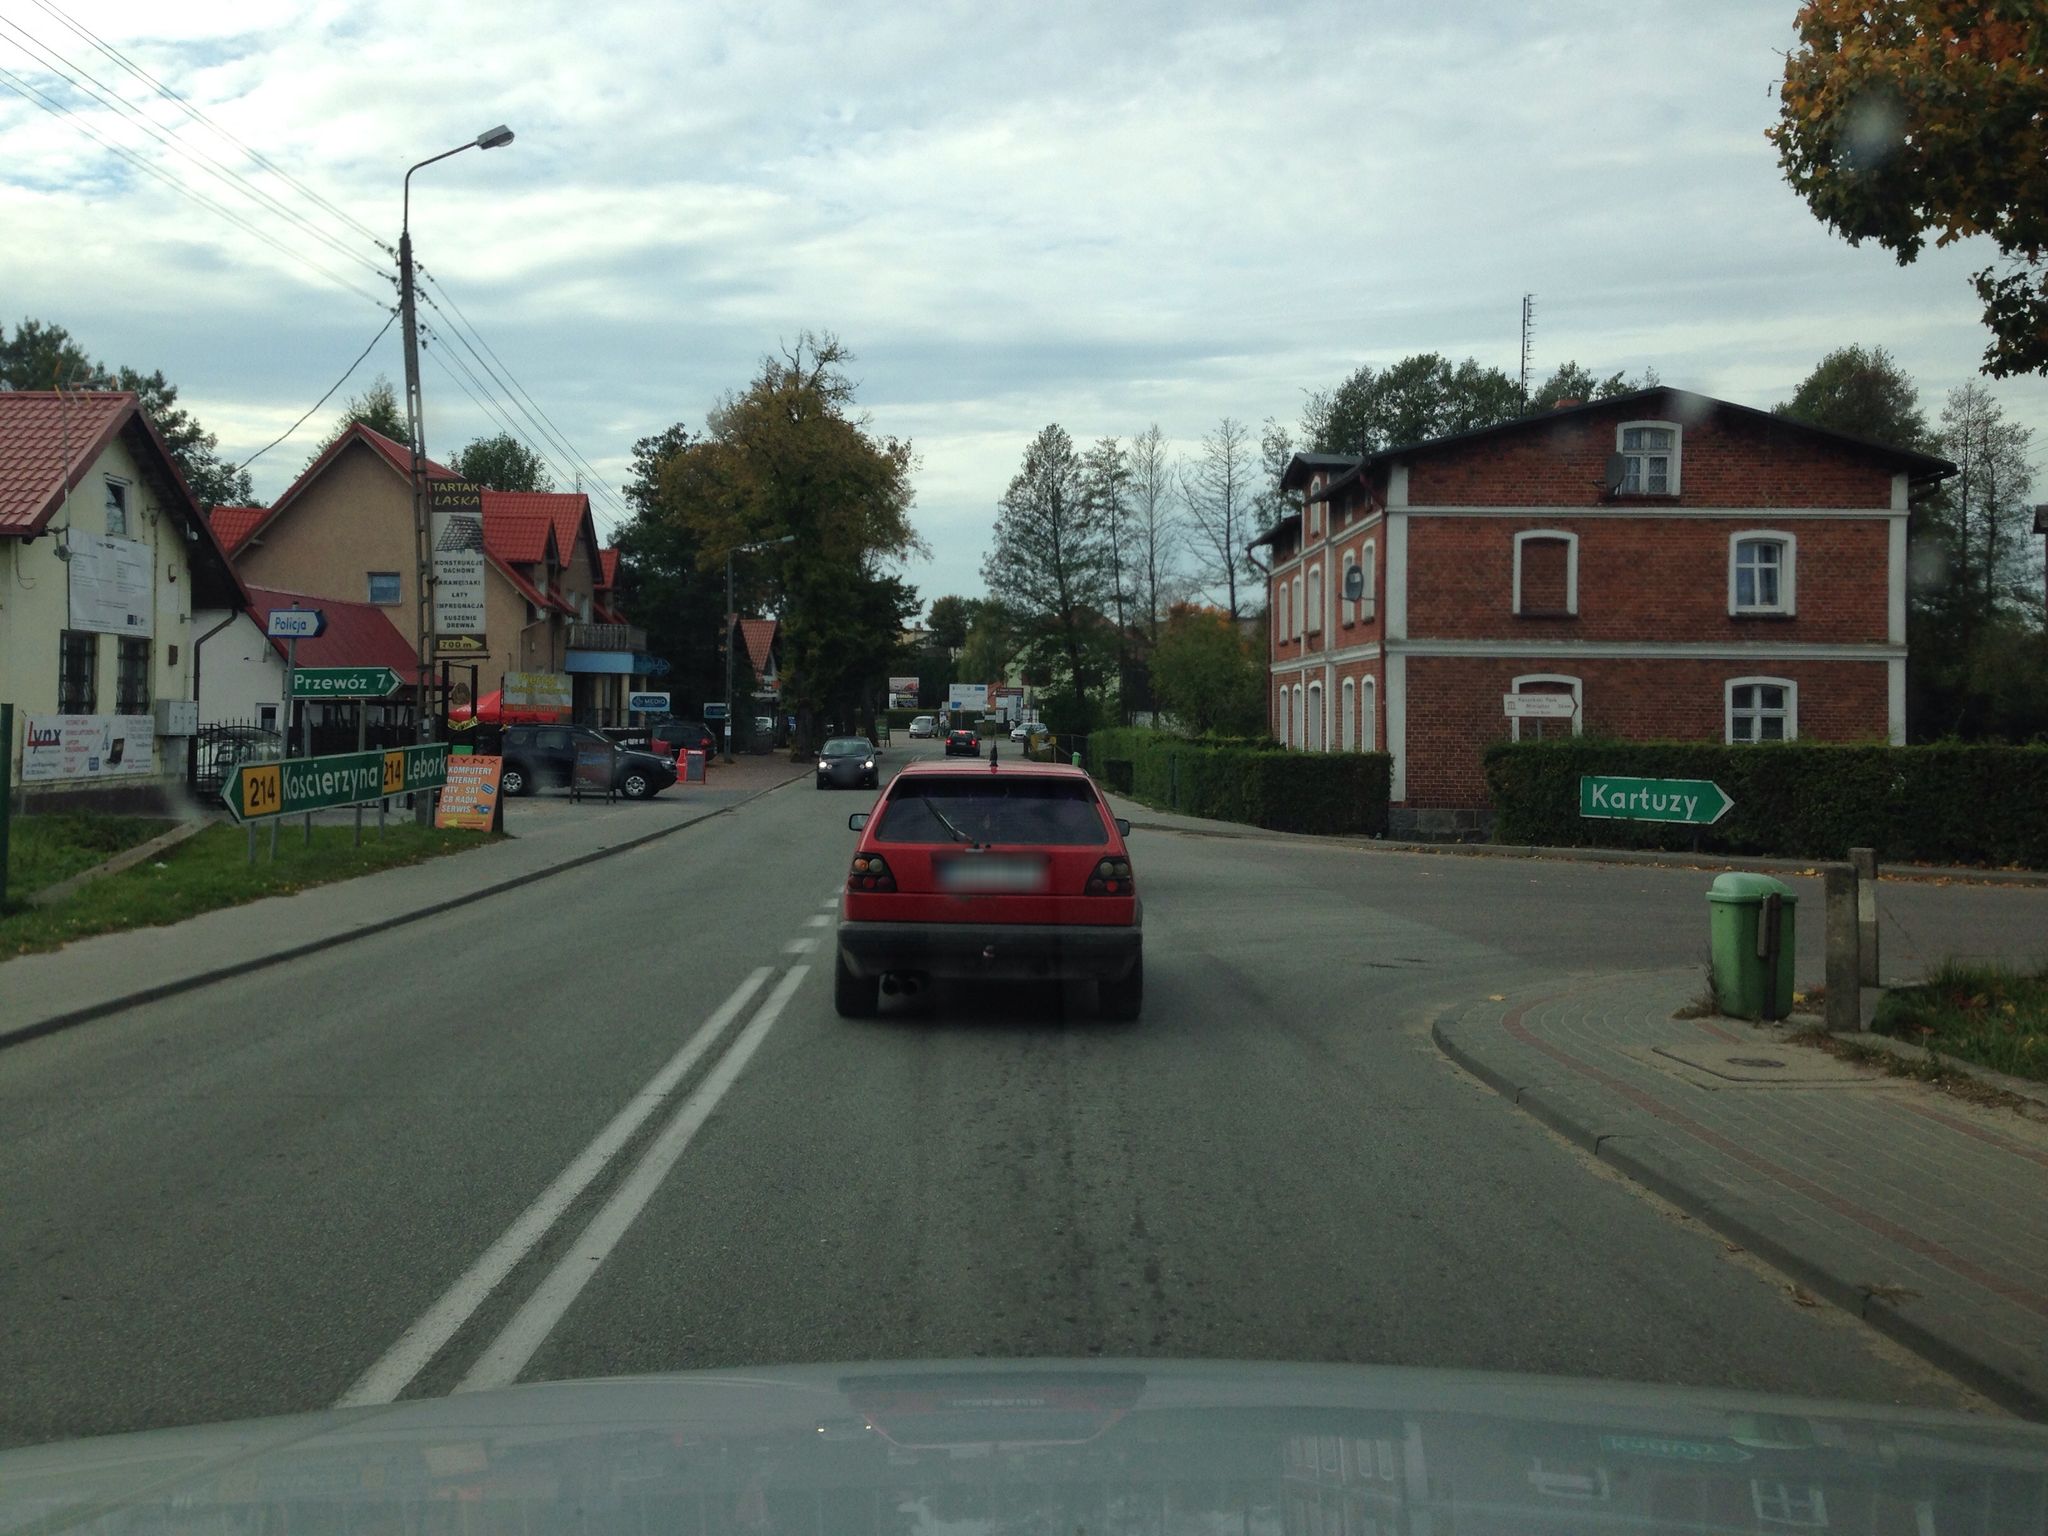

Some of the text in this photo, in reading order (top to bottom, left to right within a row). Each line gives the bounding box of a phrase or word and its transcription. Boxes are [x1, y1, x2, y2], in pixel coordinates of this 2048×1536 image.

[432, 482, 480, 492] TARTAK
[435, 495, 480, 506] LASKA
[275, 616, 307, 633] Policja
[293, 673, 387, 690] Przewóz 7
[27, 720, 62, 754] Lynx
[451, 757, 499, 765] LYNX
[447, 766, 493, 775] KOMPUTERY
[249, 749, 447, 807] 214 Kościerzyna 214 Lębork
[446, 776, 481, 785] INTERNET
[445, 785, 459, 794] RTV
[465, 786, 480, 794] SAT
[1592, 784, 1698, 820] Kartuzy
[441, 804, 471, 813] SERWIS
